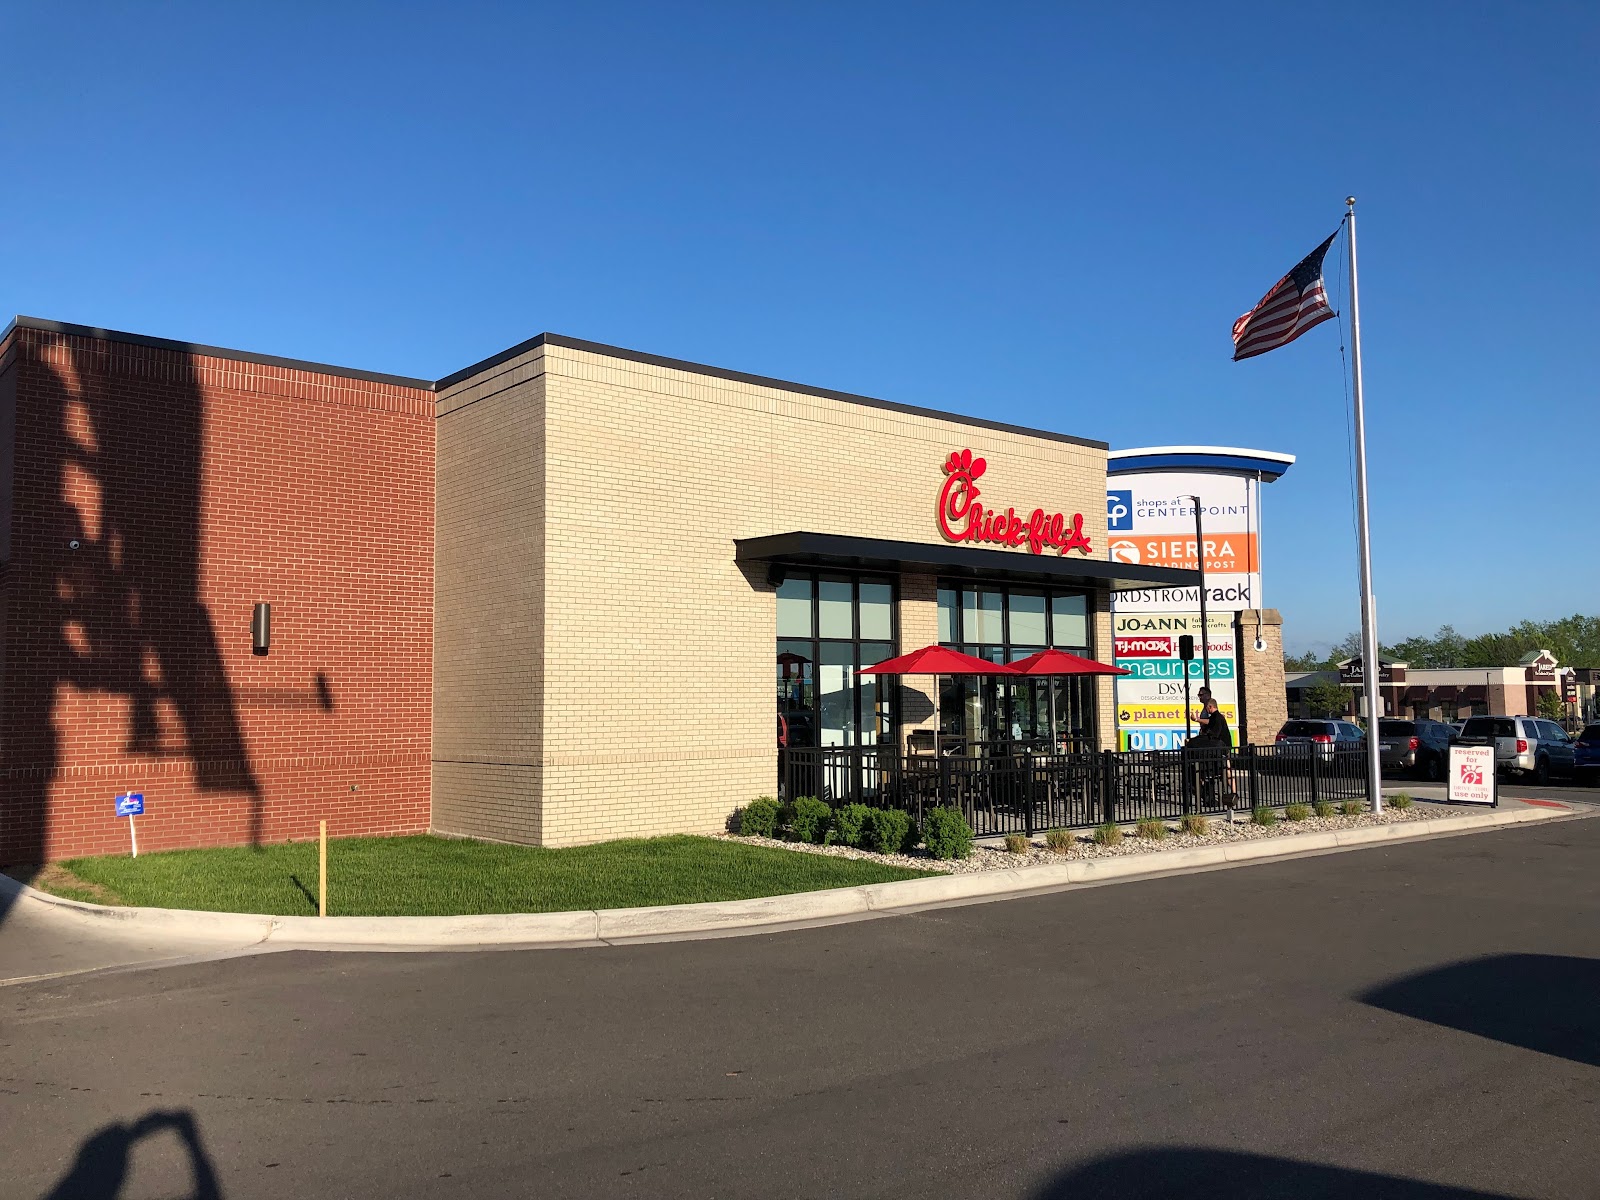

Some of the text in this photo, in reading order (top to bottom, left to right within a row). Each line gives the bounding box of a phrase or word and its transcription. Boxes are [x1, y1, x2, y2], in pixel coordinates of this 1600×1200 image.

[1136, 499, 1168, 508] shops
[938, 470, 1093, 555] Chick-fil-A
[1137, 506, 1248, 517] CENTERPOINT
[1146, 540, 1236, 559] SIERRA
[1206, 560, 1236, 569] POST
[1204, 582, 1250, 602] rack
[1133, 708, 1180, 721] planet
[1130, 732, 1168, 750] OLD
[1454, 749, 1490, 757] reserved
[1470, 792, 1489, 800] only
